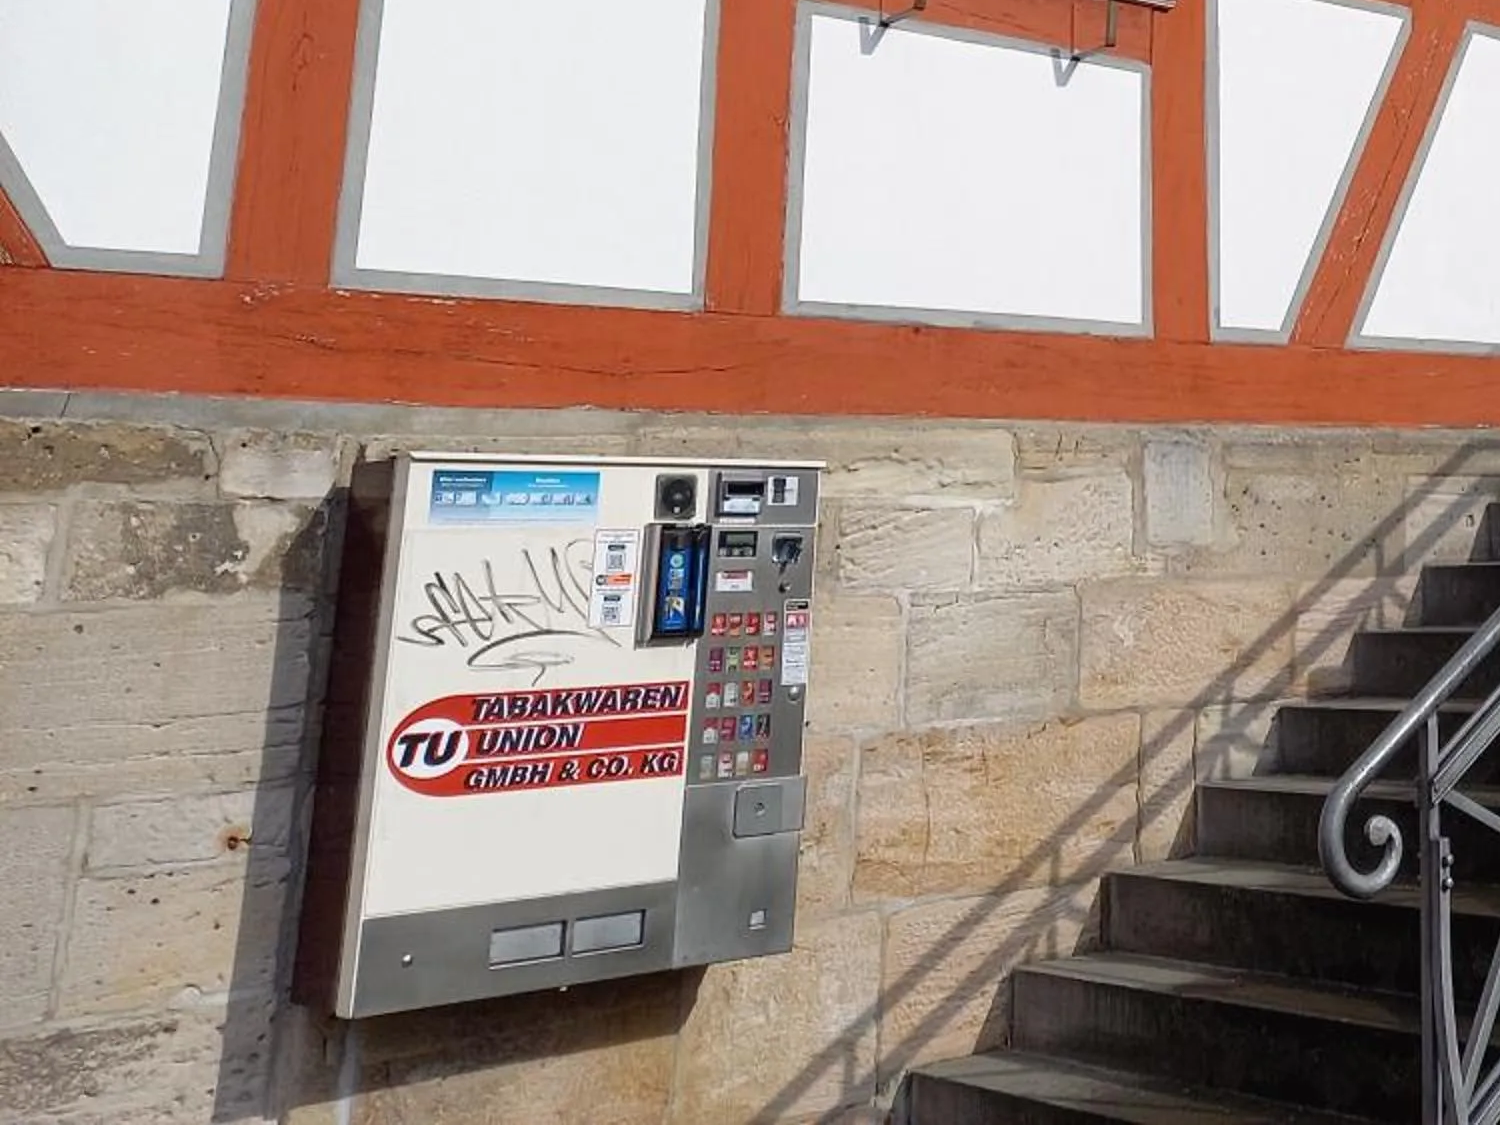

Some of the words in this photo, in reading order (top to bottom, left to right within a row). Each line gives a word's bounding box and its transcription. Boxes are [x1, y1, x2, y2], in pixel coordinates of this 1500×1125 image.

[471, 686, 682, 721] TABAKWAREN
[398, 731, 462, 768] TU
[477, 723, 584, 755] UNION
[464, 761, 554, 790] GMBH
[557, 760, 582, 782] &
[587, 756, 634, 780] CO.
[640, 751, 680, 774] KG
